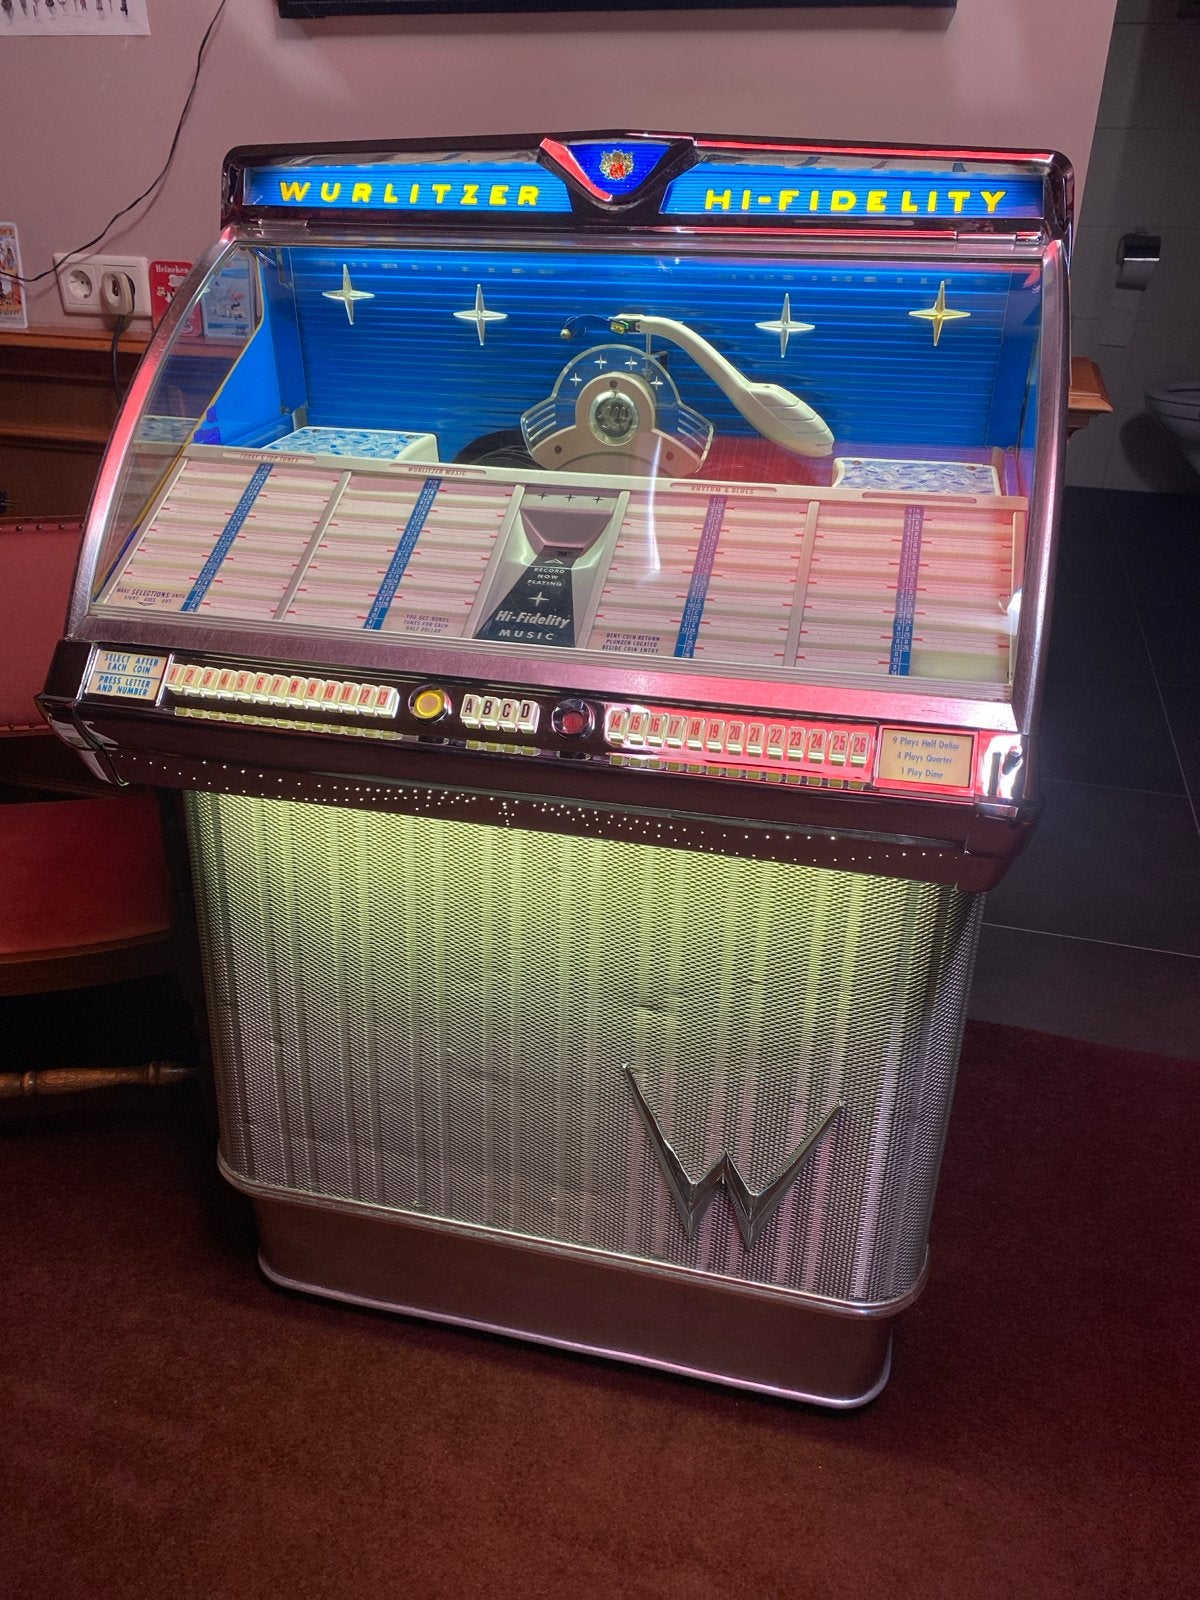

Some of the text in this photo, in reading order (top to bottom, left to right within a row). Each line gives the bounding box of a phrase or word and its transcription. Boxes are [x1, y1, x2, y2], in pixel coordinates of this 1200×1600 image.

[280, 181, 540, 206] WURLITZER
[704, 189, 1006, 214] HI-FIDELITY
[156, 264, 189, 273] Heineken
[534, 567, 565, 575] RECORD
[528, 580, 562, 588] PLAYING
[131, 589, 170, 599] SELECTIONS
[495, 610, 571, 629] Hi-Fidelity
[498, 629, 554, 641] MUSIC
[105, 653, 159, 667] SELECT AFTER
[107, 662, 151, 674] EACH COIN
[99, 675, 151, 688] PRESS LETTER
[169, 668, 390, 706] 1 2 3 4 5 6 7 8 9 10 11 12 13
[96, 684, 148, 697] AND NUMBER
[465, 698, 531, 718] A B C D
[611, 714, 867, 753] 14 15 16 17 18 19 20 21 22 23 24 25 26
[892, 736, 961, 750] 9 Plays Half Dollar
[904, 752, 923, 763] Plays
[926, 755, 953, 765] Quarter
[907, 767, 923, 779] Play
[925, 770, 945, 779] Dime
